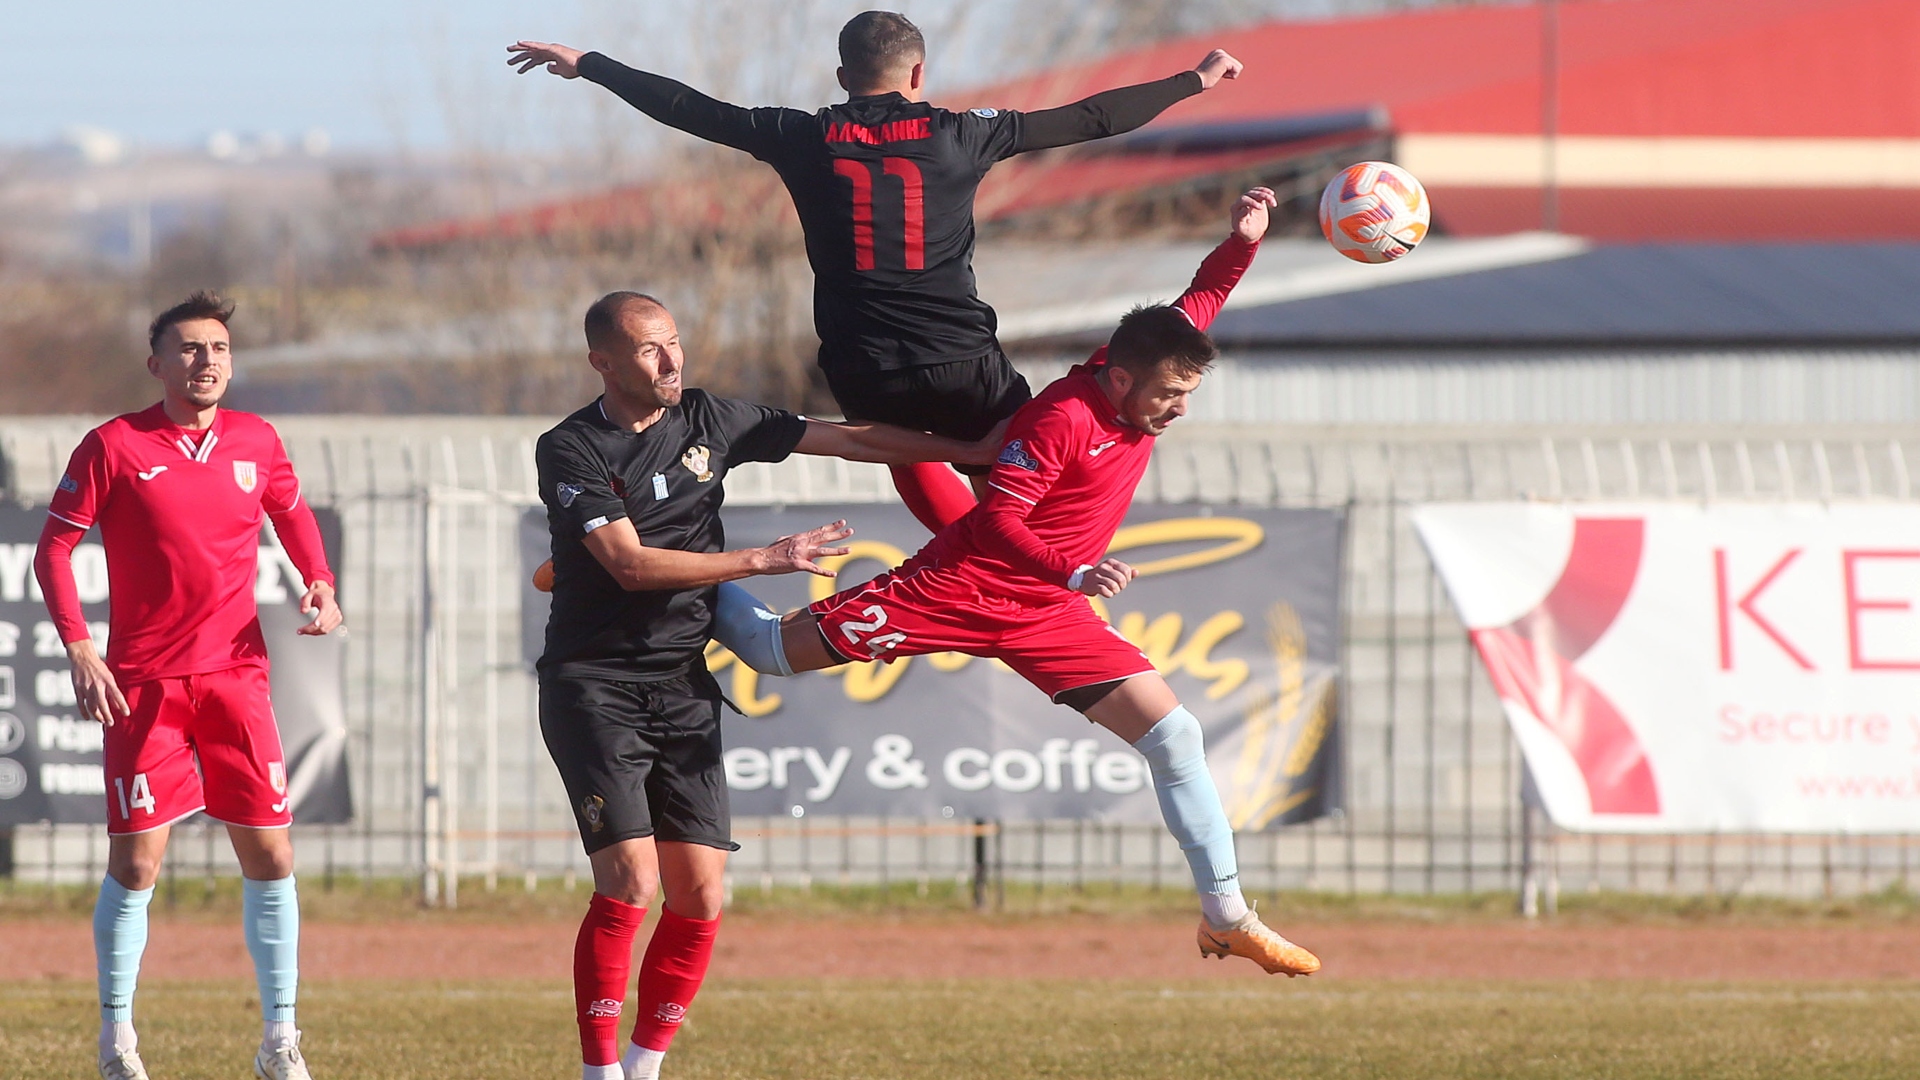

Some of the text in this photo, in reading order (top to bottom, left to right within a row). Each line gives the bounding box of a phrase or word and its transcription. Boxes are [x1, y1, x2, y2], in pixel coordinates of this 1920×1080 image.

[833, 156, 925, 271] 11
[1717, 703, 1891, 745] Secure
[114, 772, 156, 820] 14
[724, 733, 1156, 802] ery & coffe
